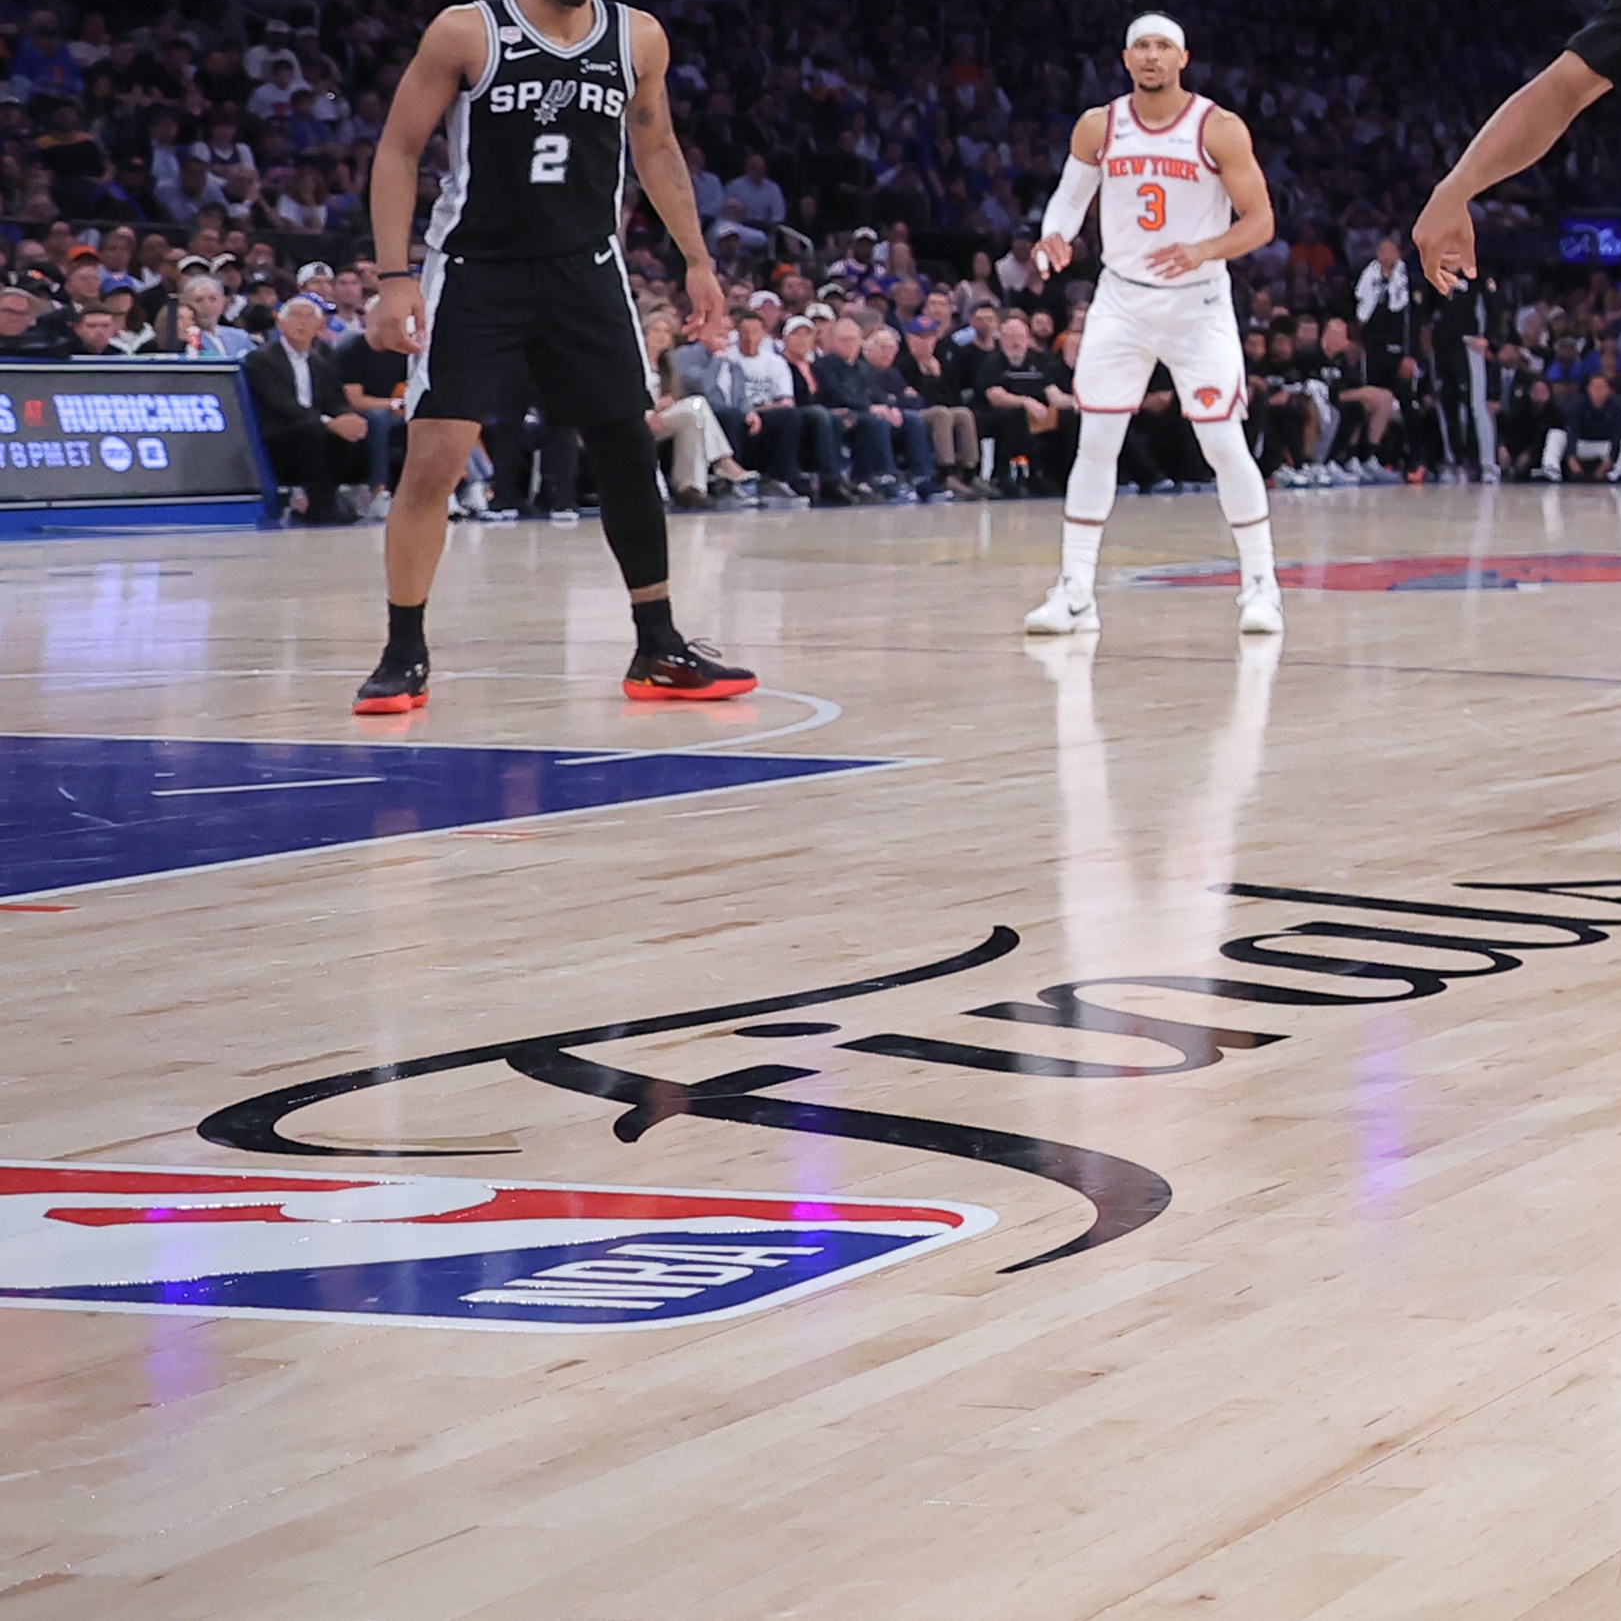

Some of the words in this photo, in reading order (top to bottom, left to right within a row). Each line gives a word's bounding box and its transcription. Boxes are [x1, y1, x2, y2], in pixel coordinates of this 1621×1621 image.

[529, 133, 570, 184] 2
[1107, 156, 1145, 178] NEW
[1151, 156, 1199, 182] YORK
[1137, 182, 1166, 231] 3
[52, 393, 226, 433] HURRICANES
[458, 1243, 826, 1311] NBA
